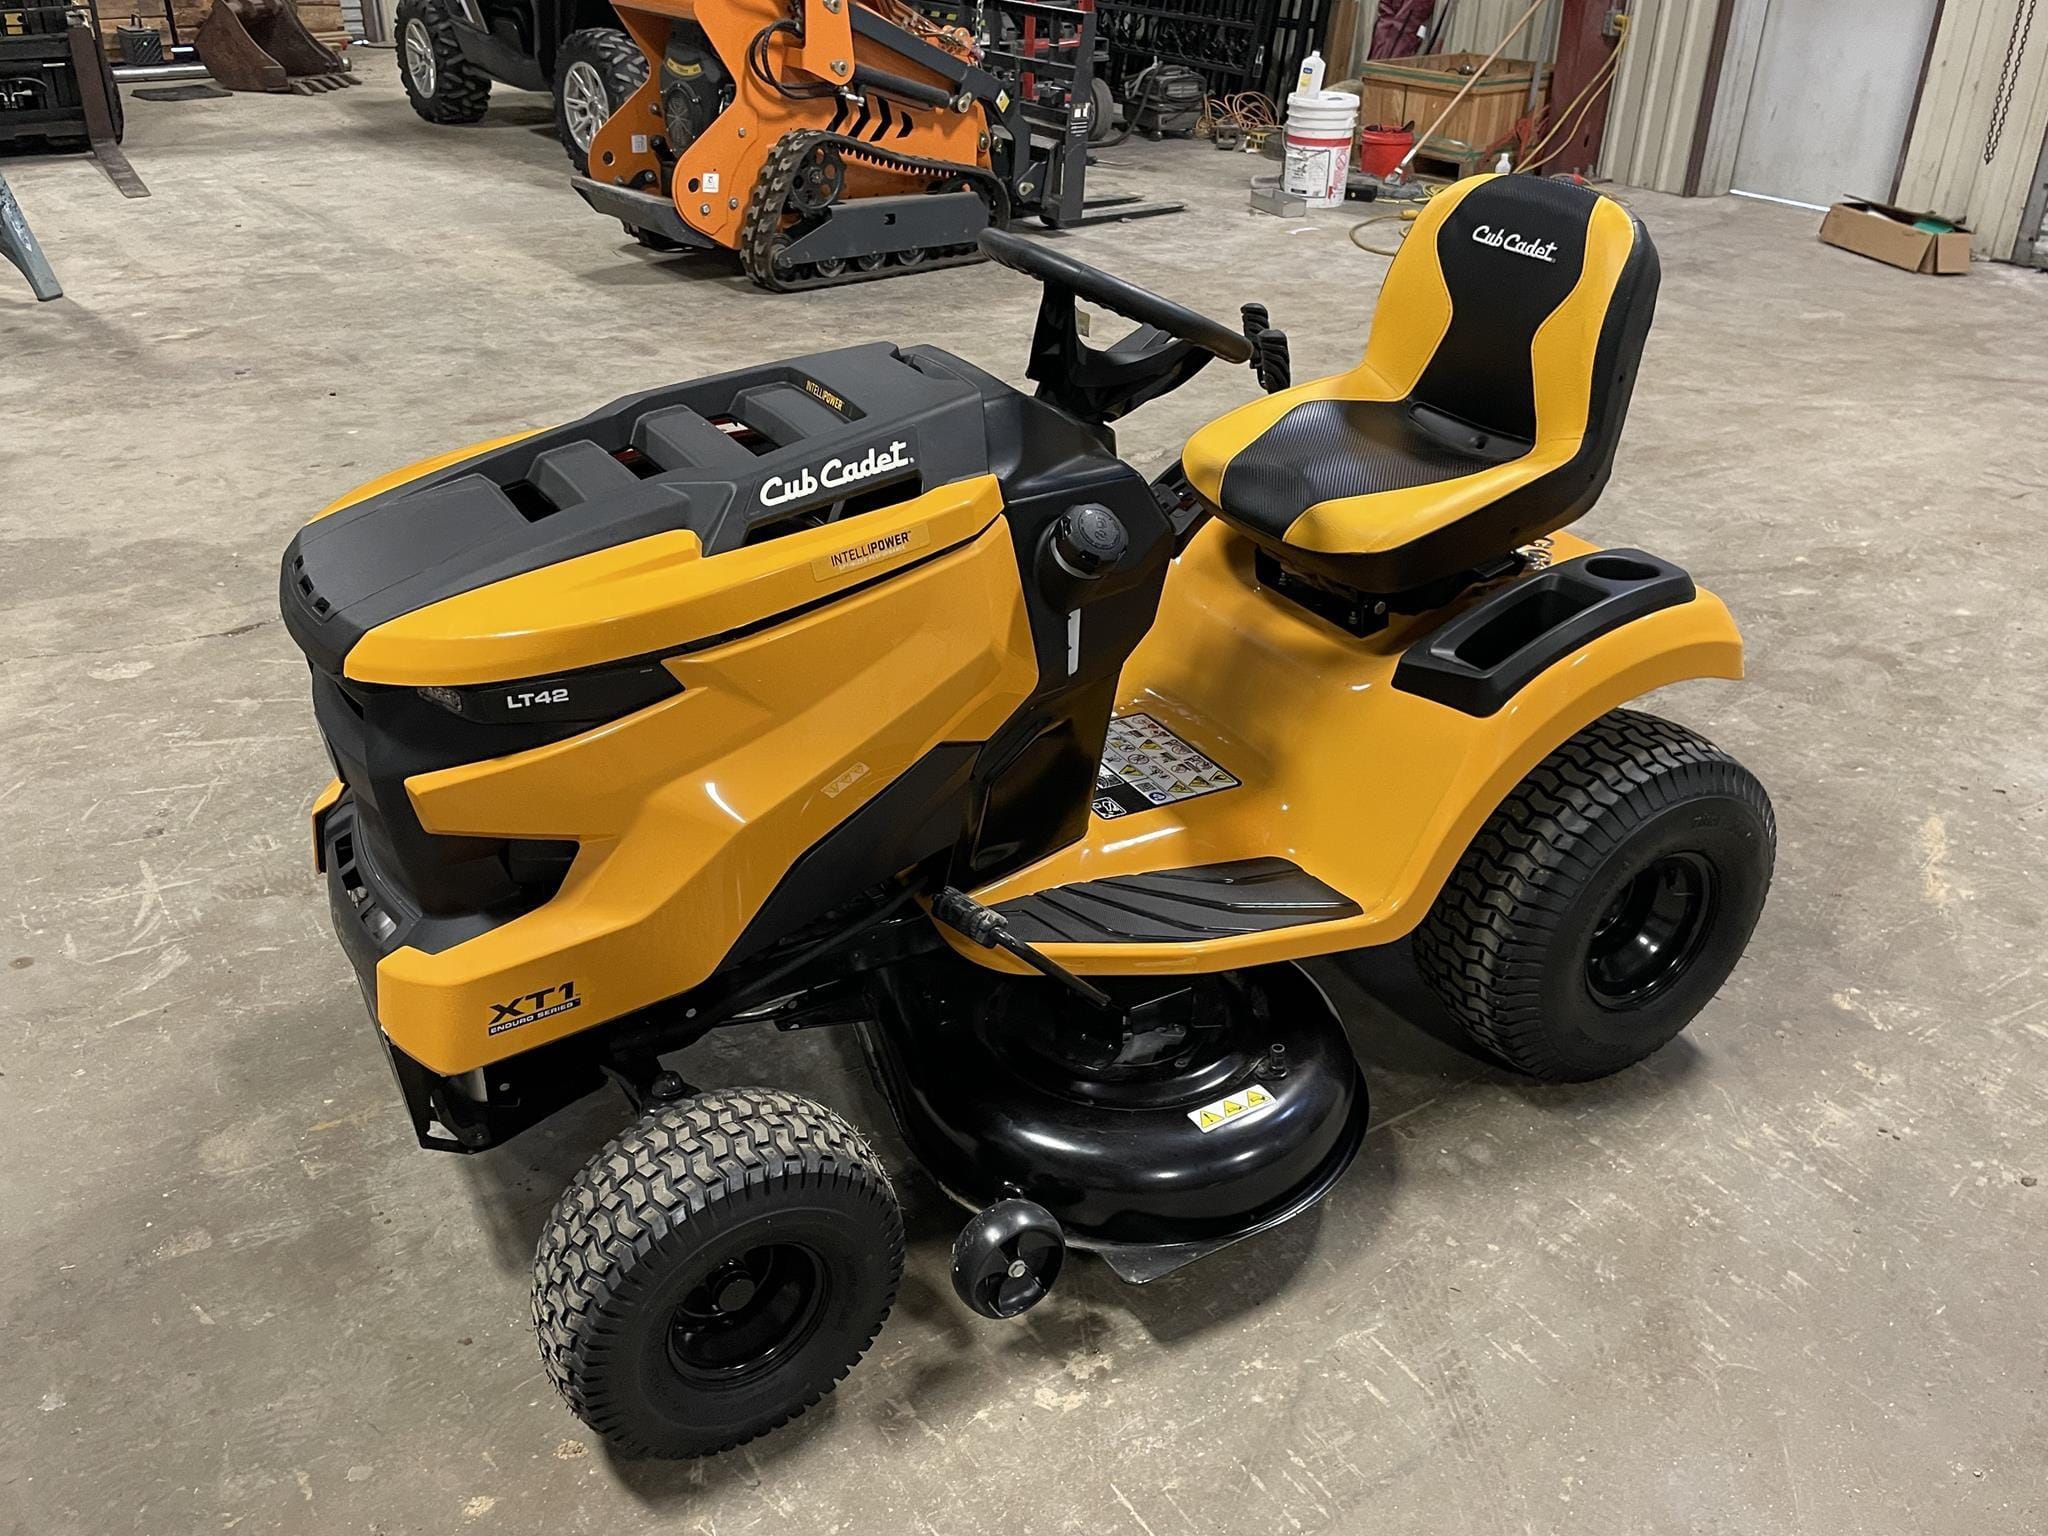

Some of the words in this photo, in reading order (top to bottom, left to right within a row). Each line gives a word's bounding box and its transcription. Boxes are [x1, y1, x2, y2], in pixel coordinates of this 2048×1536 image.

[1472, 225, 1504, 247] Cub
[1503, 234, 1557, 261] Cadet
[760, 468, 818, 506] Cub
[507, 688, 569, 709] LT42
[488, 981, 574, 1025] XT1
[490, 1015, 534, 1034] ENDURO
[537, 1001, 574, 1018] SERIES
